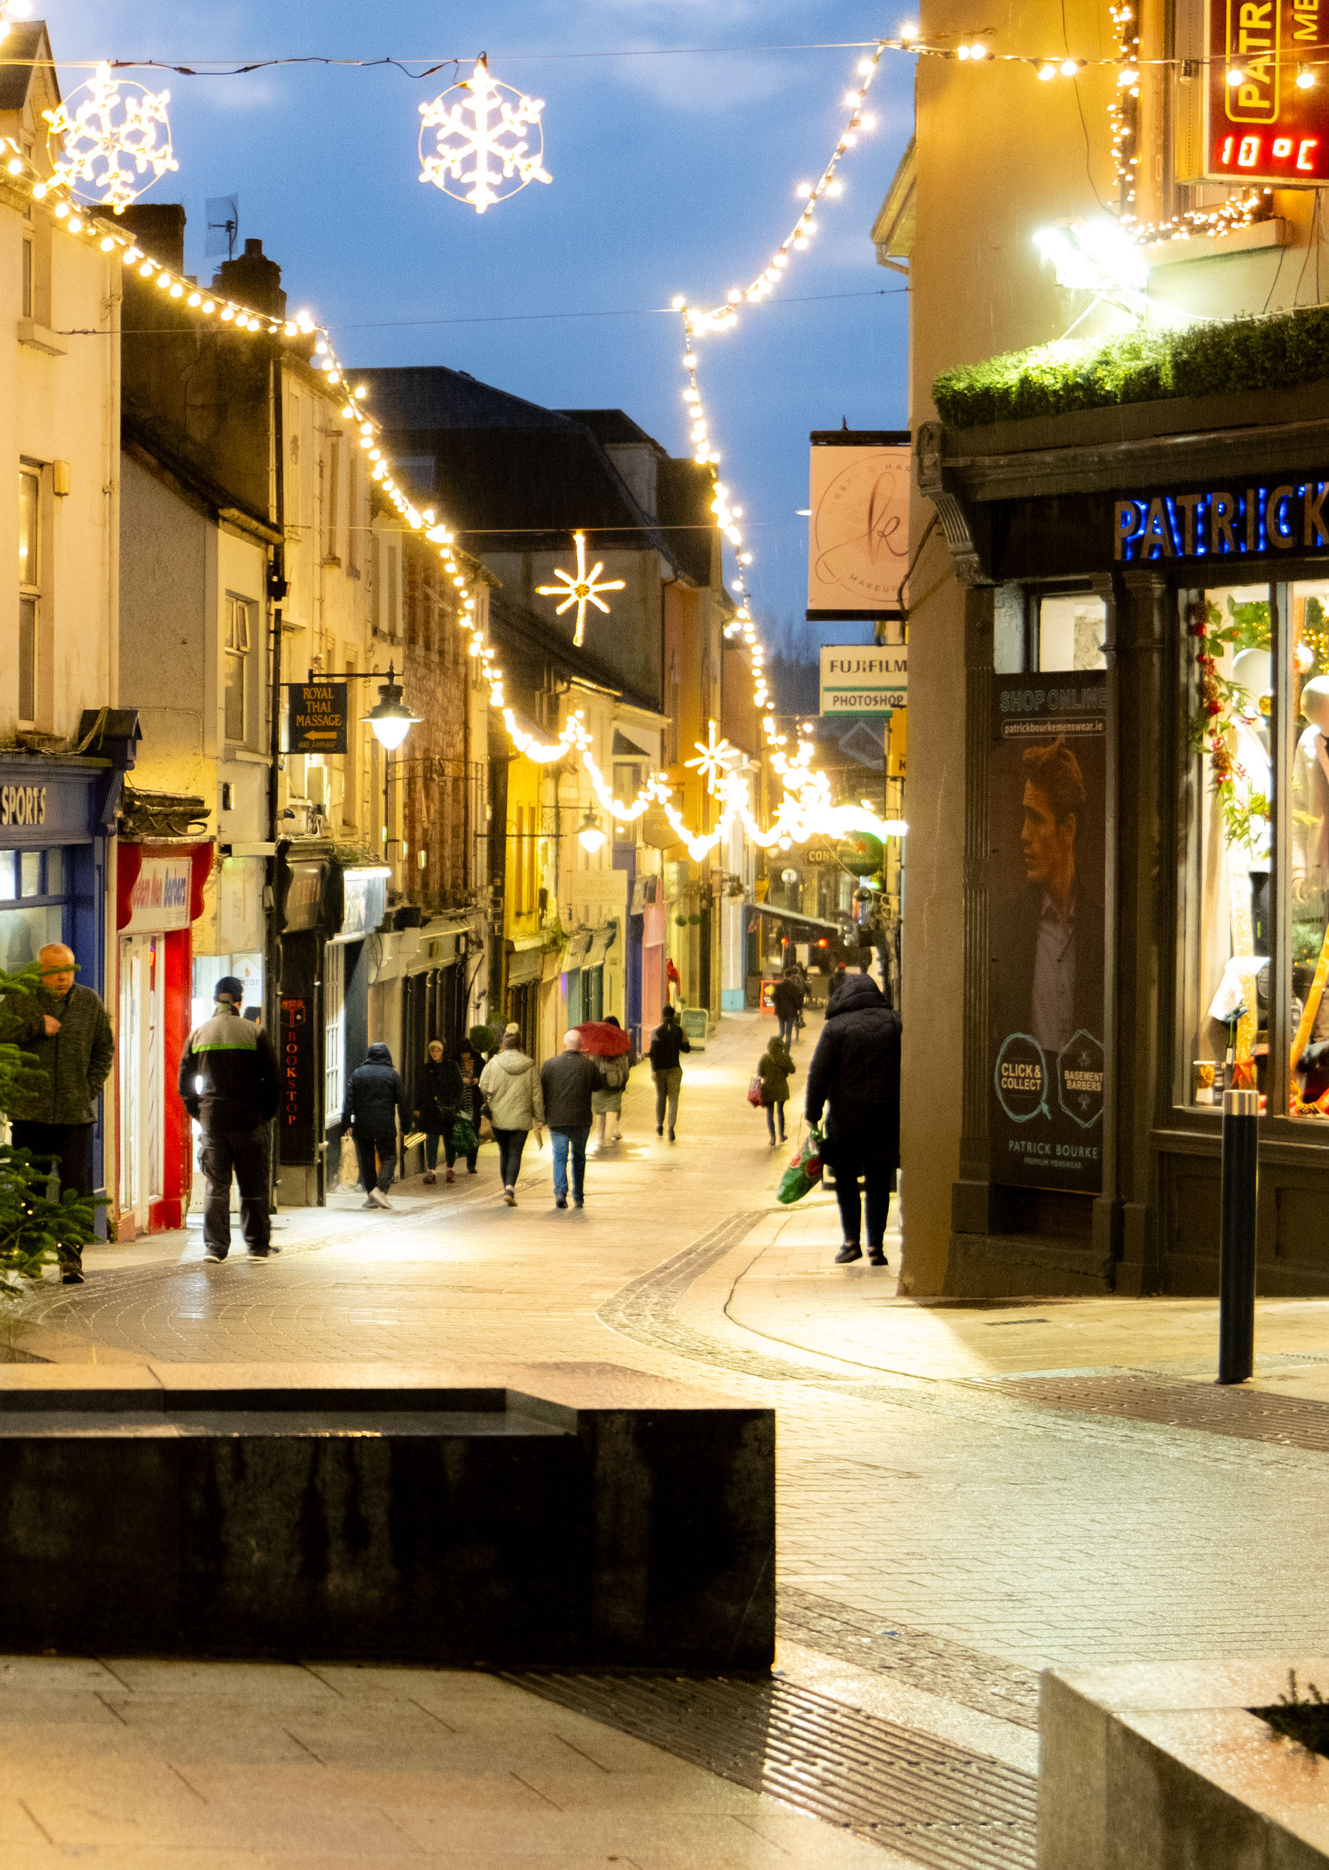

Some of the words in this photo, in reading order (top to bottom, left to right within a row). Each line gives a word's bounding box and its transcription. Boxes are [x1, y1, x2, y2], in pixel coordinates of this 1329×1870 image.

[1113, 480, 1329, 561] PATRICK
[849, 573, 898, 594] MAKEUP
[830, 659, 907, 673] FUJIFILM
[303, 687, 334, 700] ROYAL
[832, 694, 904, 707] PHOTOSHOP
[999, 689, 1045, 712] SHOP
[1046, 687, 1107, 710] ONLINE
[305, 700, 331, 713] THAI
[295, 714, 342, 727] MASSAGE
[1004, 720, 1103, 735] patrickbourkemenswear.ie
[1, 785, 47, 826] SPORTS
[1001, 1062, 1033, 1078] CLICK
[1034, 1065, 1042, 1079] &
[1064, 1070, 1104, 1082] BASEMENT
[285, 1031, 298, 1125] BOOKSTOP
[1001, 1077, 1042, 1091] COLLECT
[1066, 1080, 1102, 1092] BARBERS
[1008, 1140, 1051, 1155] PATRICK
[1055, 1143, 1098, 1159] BOURKE
